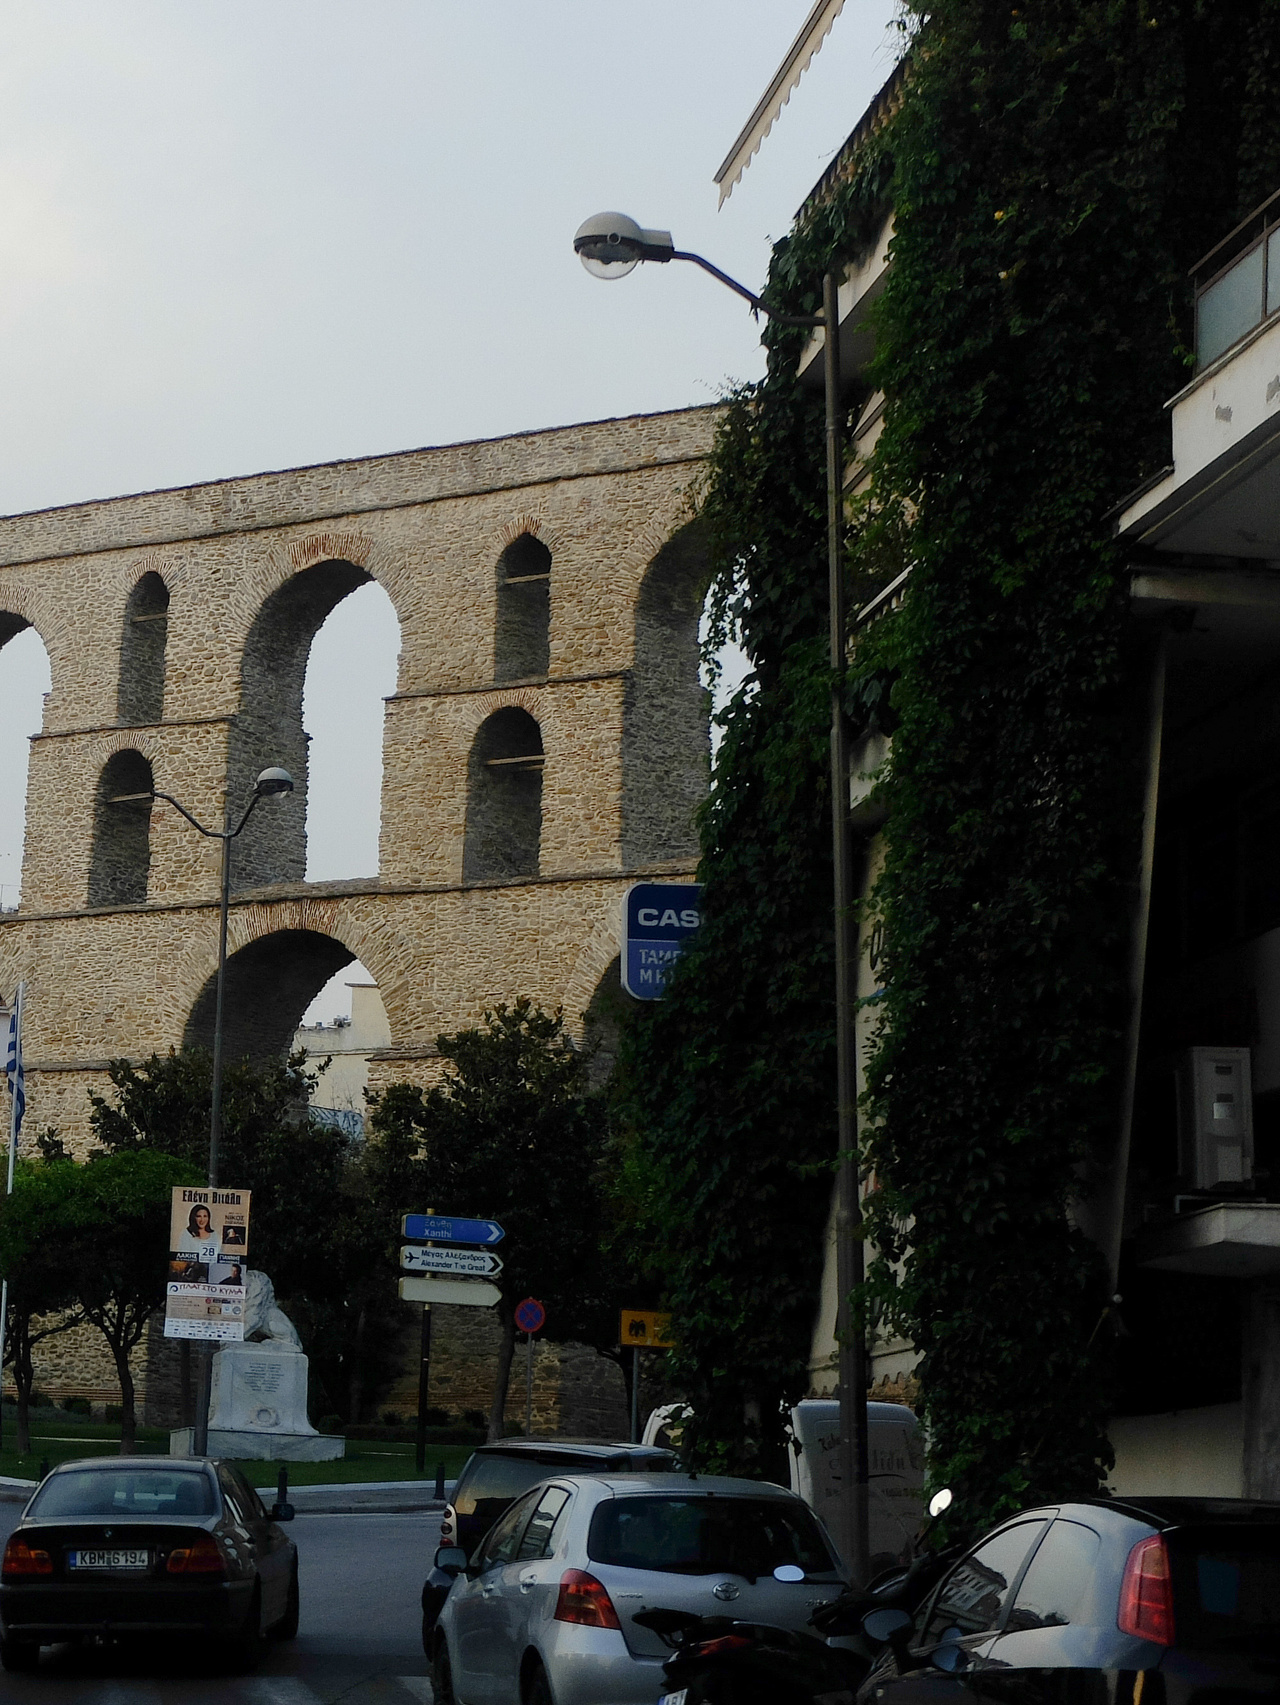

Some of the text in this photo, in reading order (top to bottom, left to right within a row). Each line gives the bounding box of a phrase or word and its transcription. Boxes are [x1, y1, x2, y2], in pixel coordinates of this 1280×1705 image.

[638, 908, 701, 928] CAS
[182, 1190, 209, 1203] Ελένη
[423, 1228, 452, 1239] Xanthi
[202, 1247, 215, 1256] 28
[421, 1260, 452, 1269] Alexander
